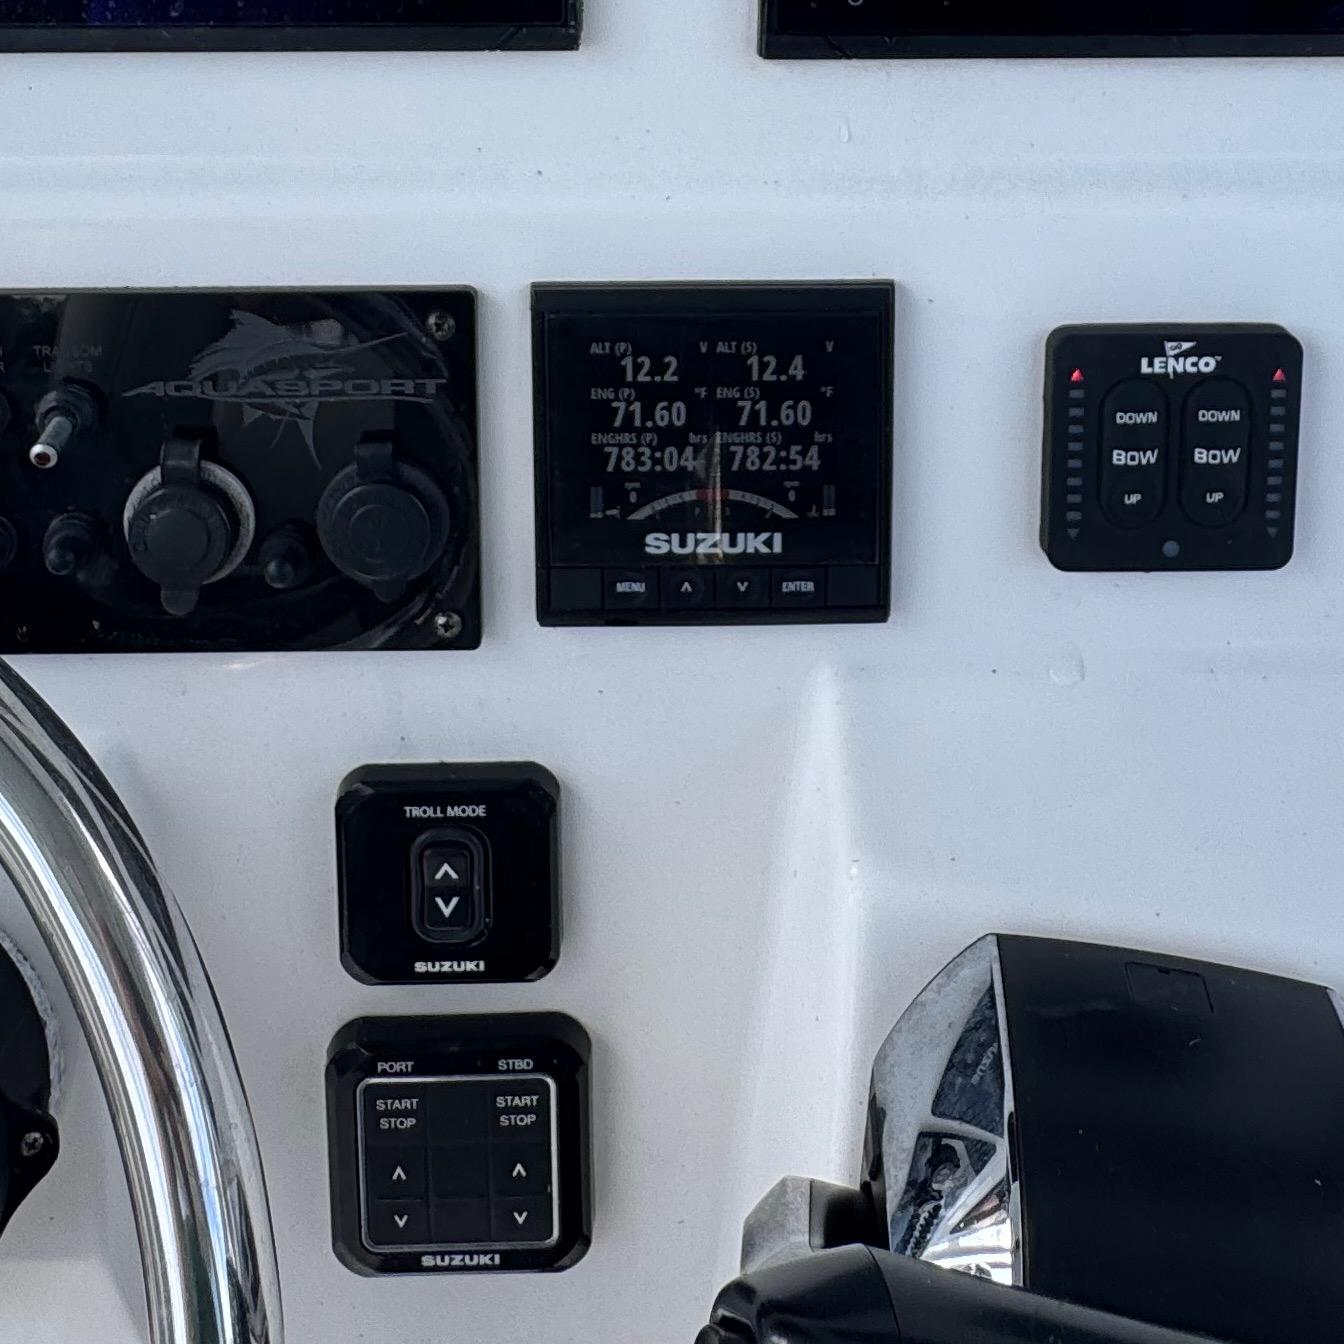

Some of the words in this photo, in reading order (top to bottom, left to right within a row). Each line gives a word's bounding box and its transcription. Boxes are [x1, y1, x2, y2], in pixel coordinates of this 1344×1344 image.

[590, 341, 612, 355] ALT
[614, 341, 632, 356] (P)
[699, 341, 707, 353] V
[716, 341, 738, 354] ALT
[740, 341, 758, 354] (S)
[825, 341, 834, 352] V
[620, 356, 679, 383] 12.2
[746, 355, 805, 381] 12.4
[1140, 356, 1216, 374] LENCO
[121, 379, 447, 397] AQUASPORT
[590, 387, 615, 399] ENG
[618, 387, 635, 400] (P)
[716, 387, 741, 399] ENG
[744, 387, 761, 400] (S)
[611, 401, 687, 428] 71.60
[737, 401, 812, 427] 71.60
[1116, 411, 1157, 424] DOWN
[1198, 409, 1240, 422] DOWN
[591, 433, 637, 444] ENGHRS
[640, 432, 658, 445] (P)
[688, 432, 707, 444] hrs
[765, 432, 782, 445] (S)
[814, 431, 833, 443] hrs
[604, 446, 696, 473] 783:04
[729, 445, 821, 472] 782:54
[1112, 448, 1159, 465] BOW
[1194, 448, 1241, 464] BOW
[1124, 493, 1142, 505] UP
[1206, 492, 1224, 503] UP
[645, 533, 782, 554] SUZUKI
[616, 582, 646, 592] MENU
[782, 581, 815, 592] ENTER
[404, 806, 444, 818] TROLL
[447, 805, 486, 817] MODE
[414, 960, 485, 973] SUZUKI
[377, 1061, 414, 1073] PORT
[498, 1058, 534, 1071] STBD
[376, 1098, 418, 1111] START
[495, 1095, 538, 1108] START
[380, 1117, 416, 1130] STOP
[499, 1113, 537, 1126] STOP
[421, 1254, 500, 1267] SUZUKI
